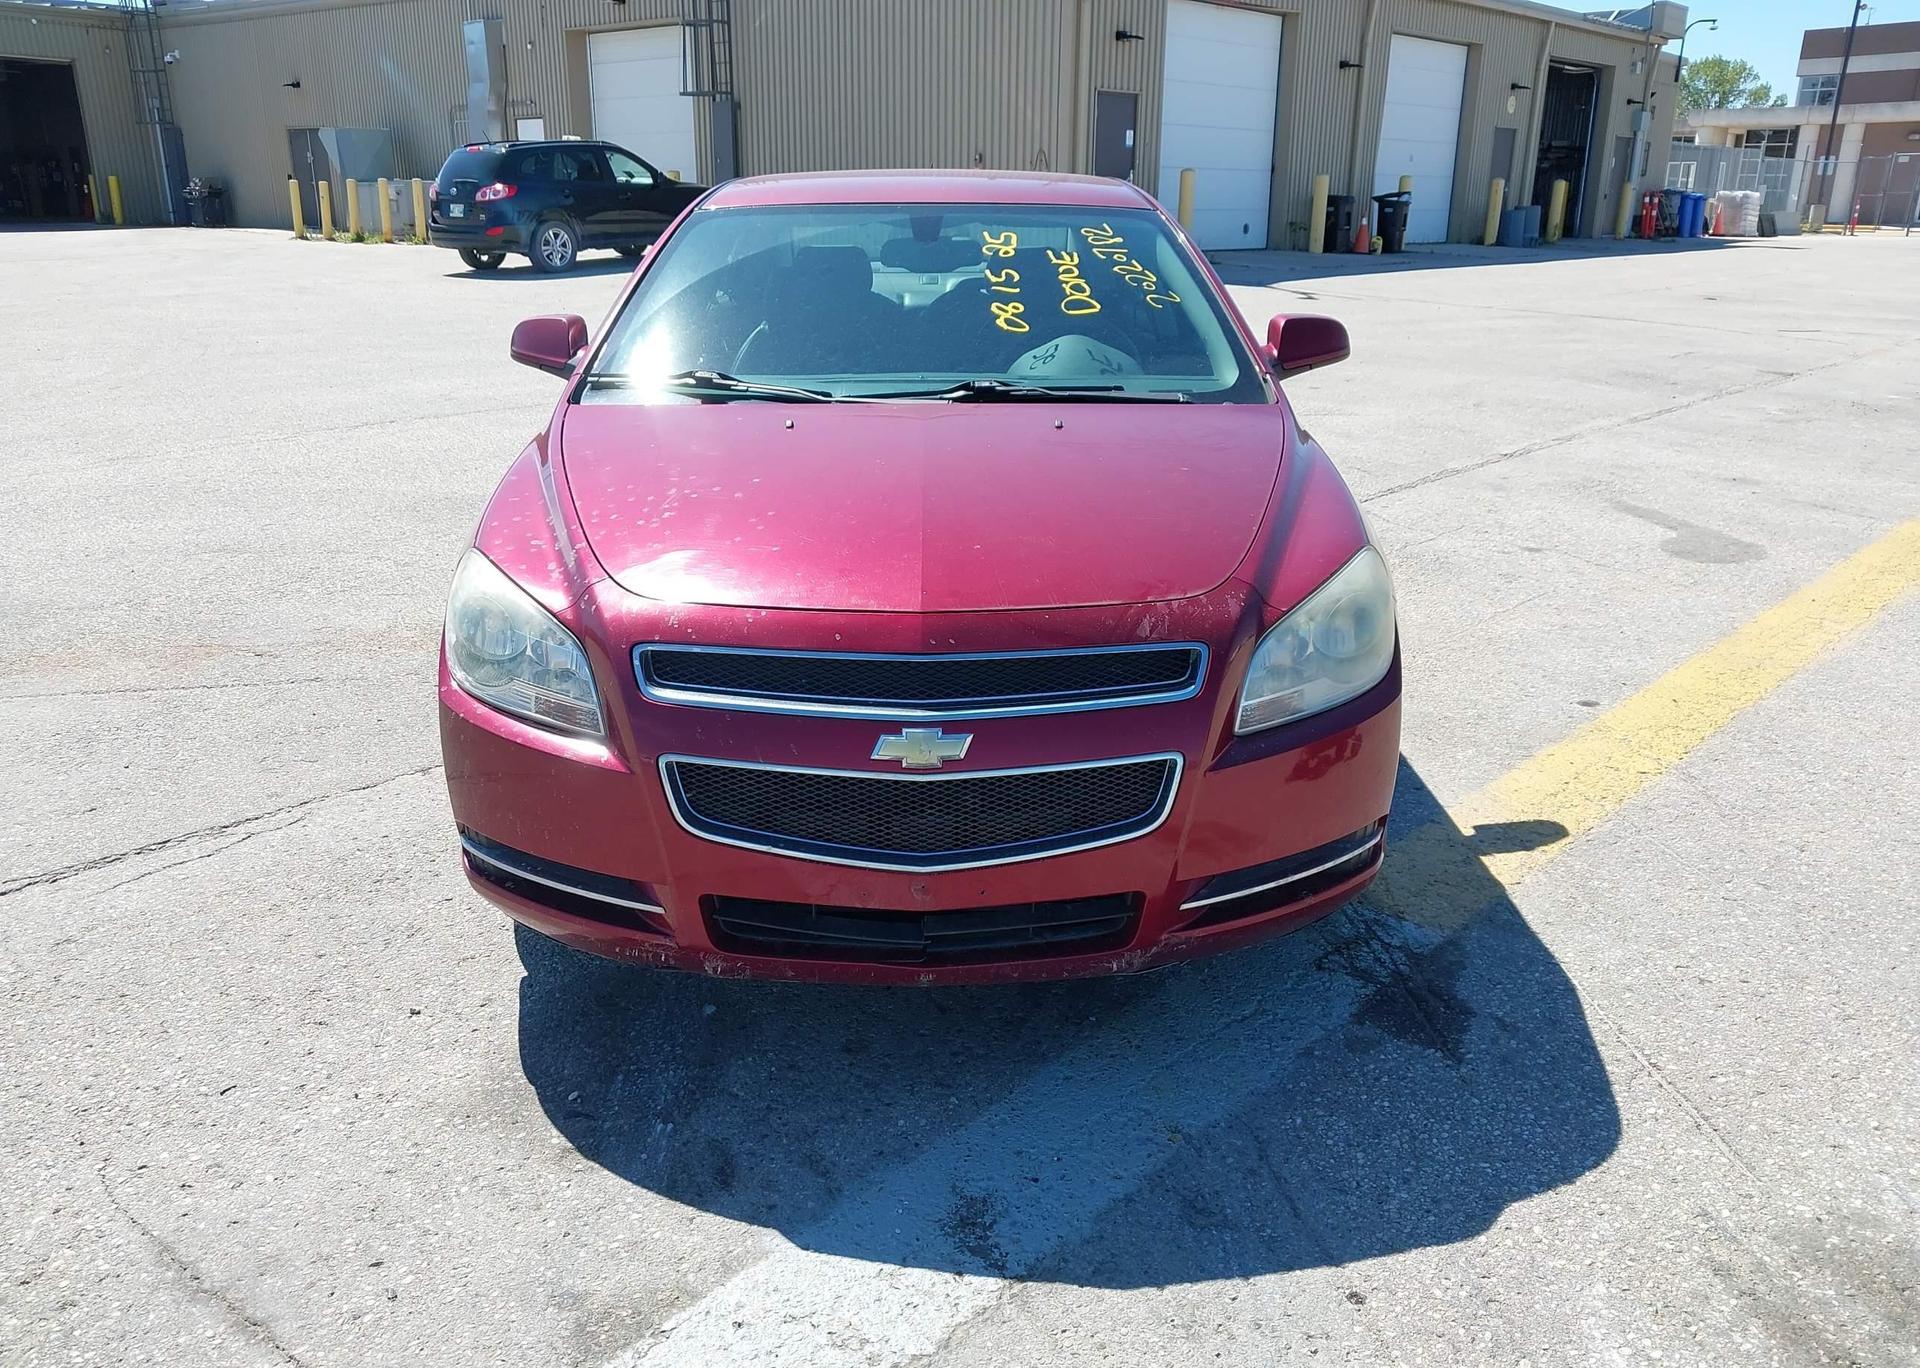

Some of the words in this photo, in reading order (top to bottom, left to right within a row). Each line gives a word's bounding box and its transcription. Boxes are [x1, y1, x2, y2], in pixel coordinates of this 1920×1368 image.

[982, 231, 1018, 258] 25
[984, 268, 1021, 293] 15
[1046, 249, 1102, 315] DONE
[990, 302, 1030, 333] 08
